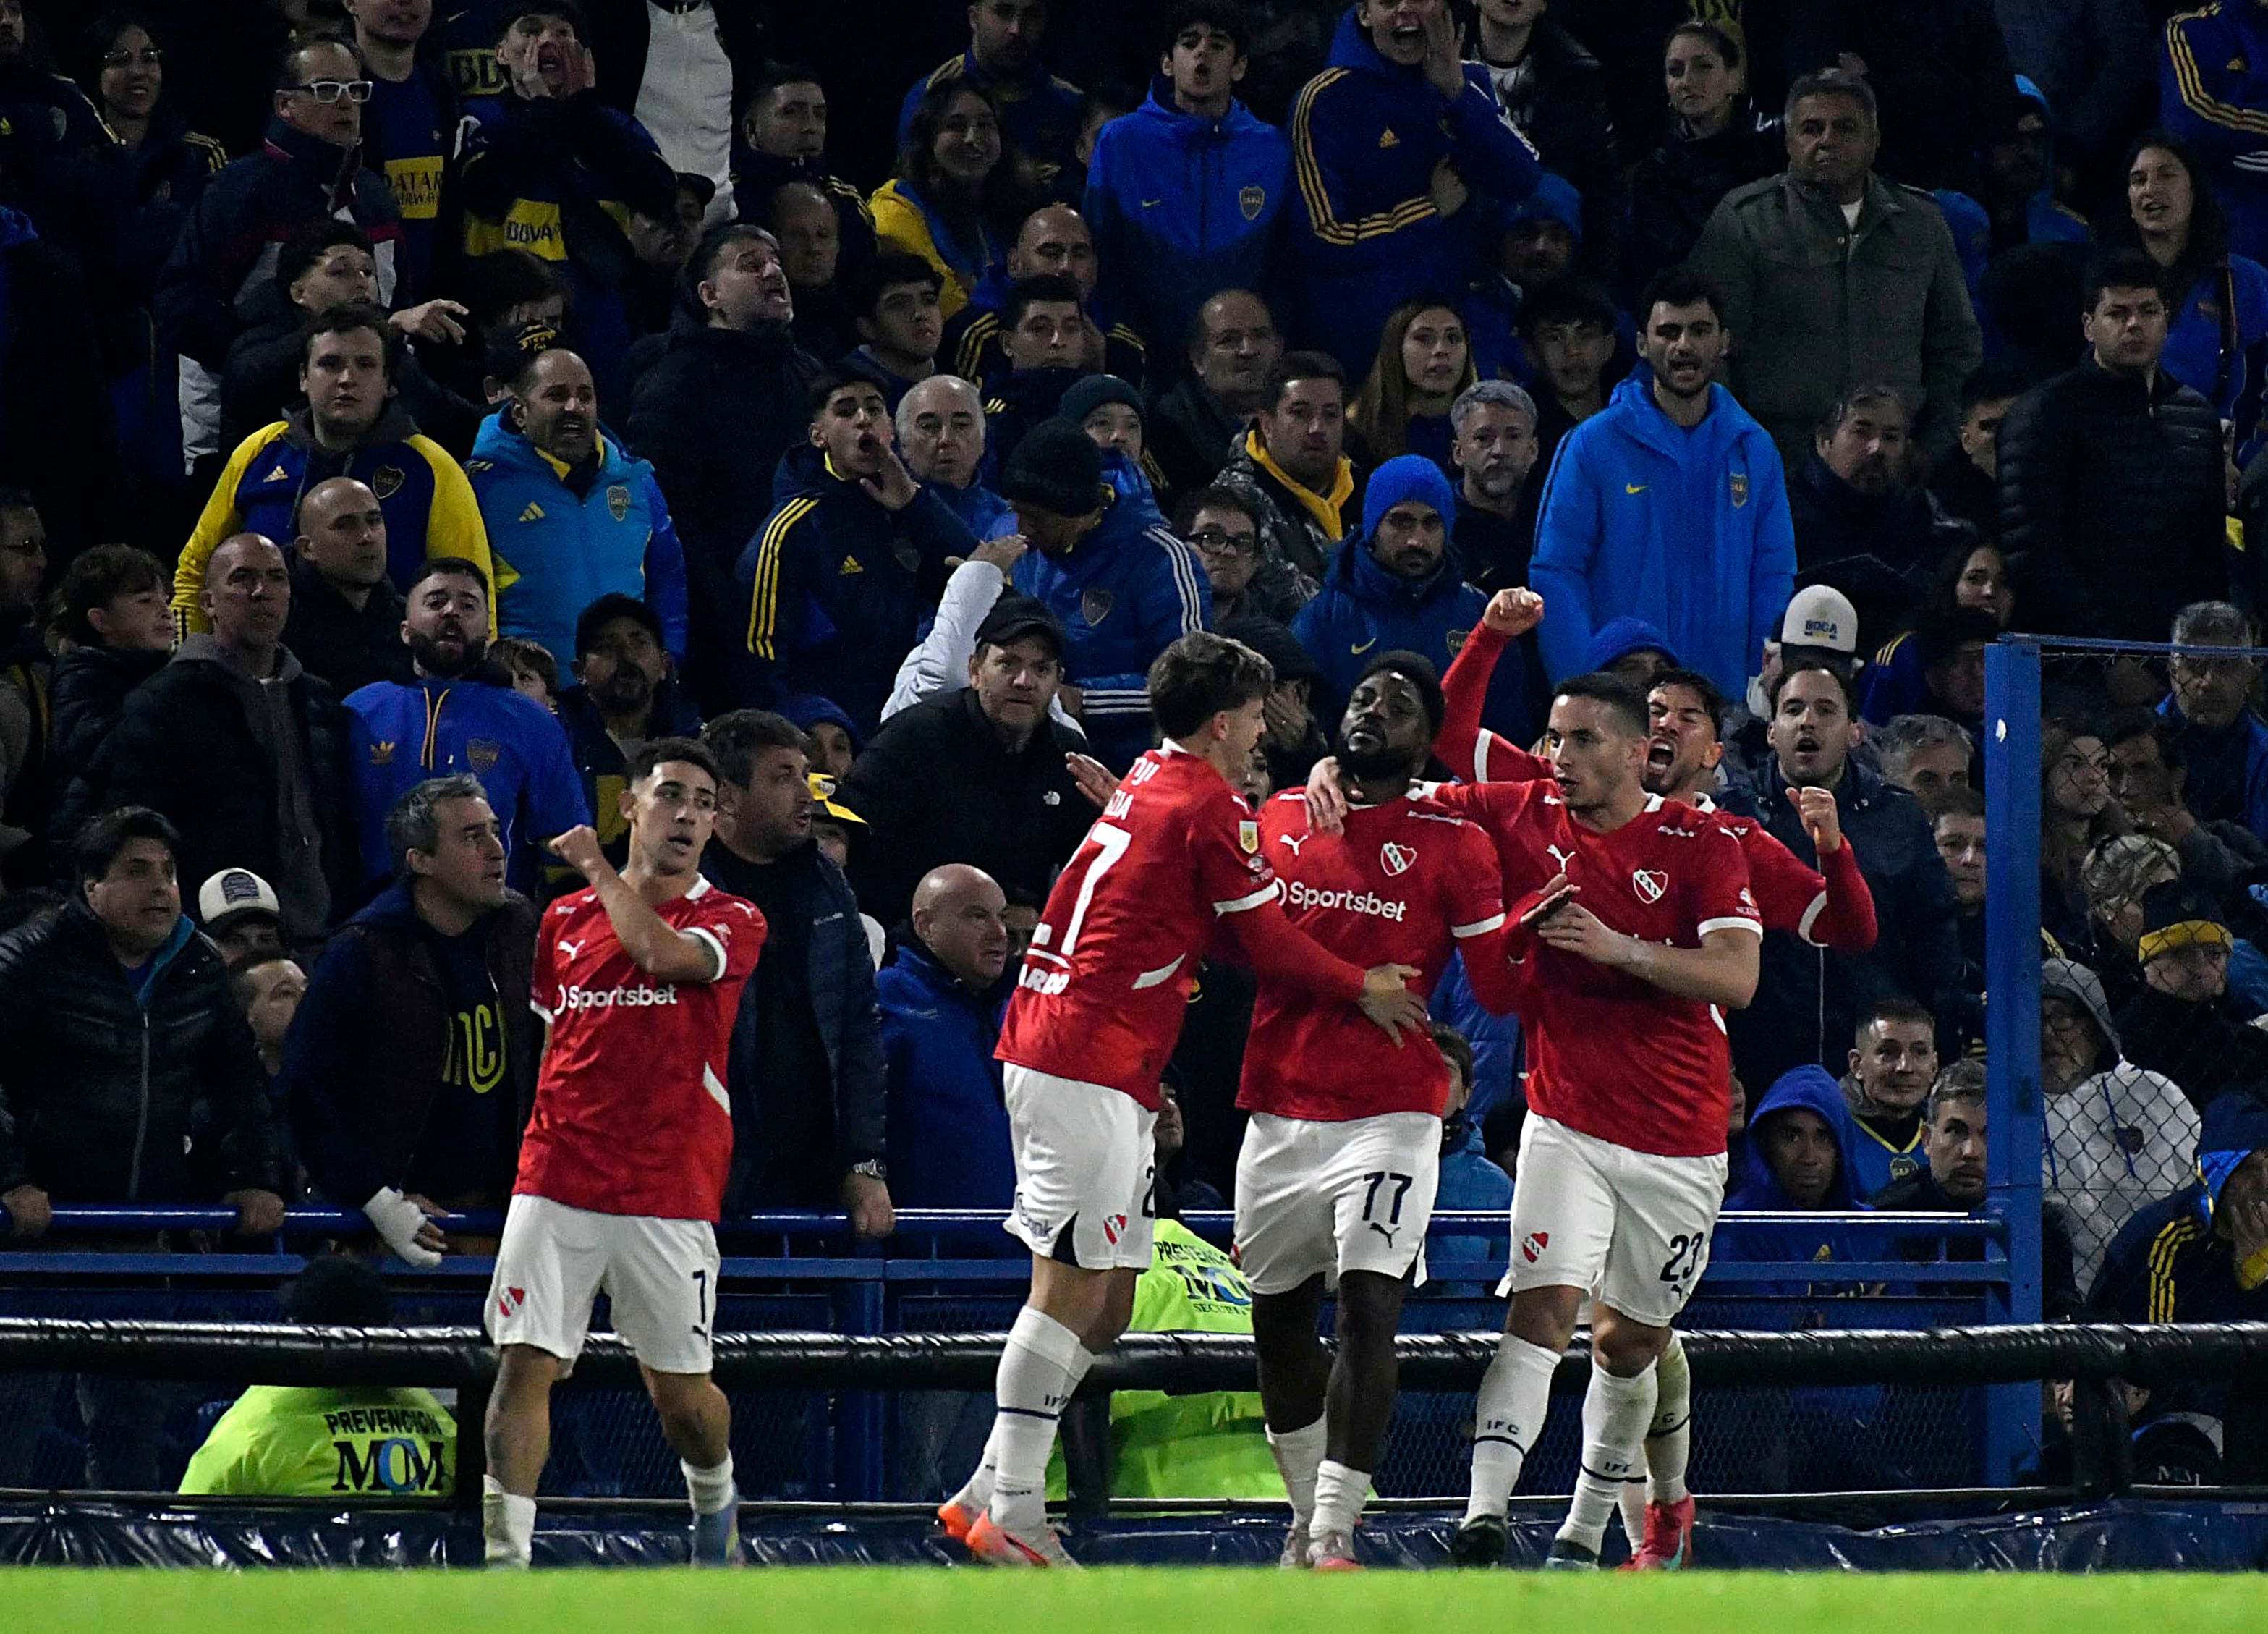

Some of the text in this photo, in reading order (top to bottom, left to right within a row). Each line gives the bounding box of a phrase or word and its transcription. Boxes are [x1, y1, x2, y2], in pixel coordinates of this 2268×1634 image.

[1289, 881, 1406, 922] Sportsbet
[566, 983, 678, 1012] Sportsbet
[1362, 1171, 1413, 1224] 77
[1659, 1232, 1704, 1282] 23
[1487, 1419, 1519, 1436] IFC
[331, 1437, 445, 1494] MOM
